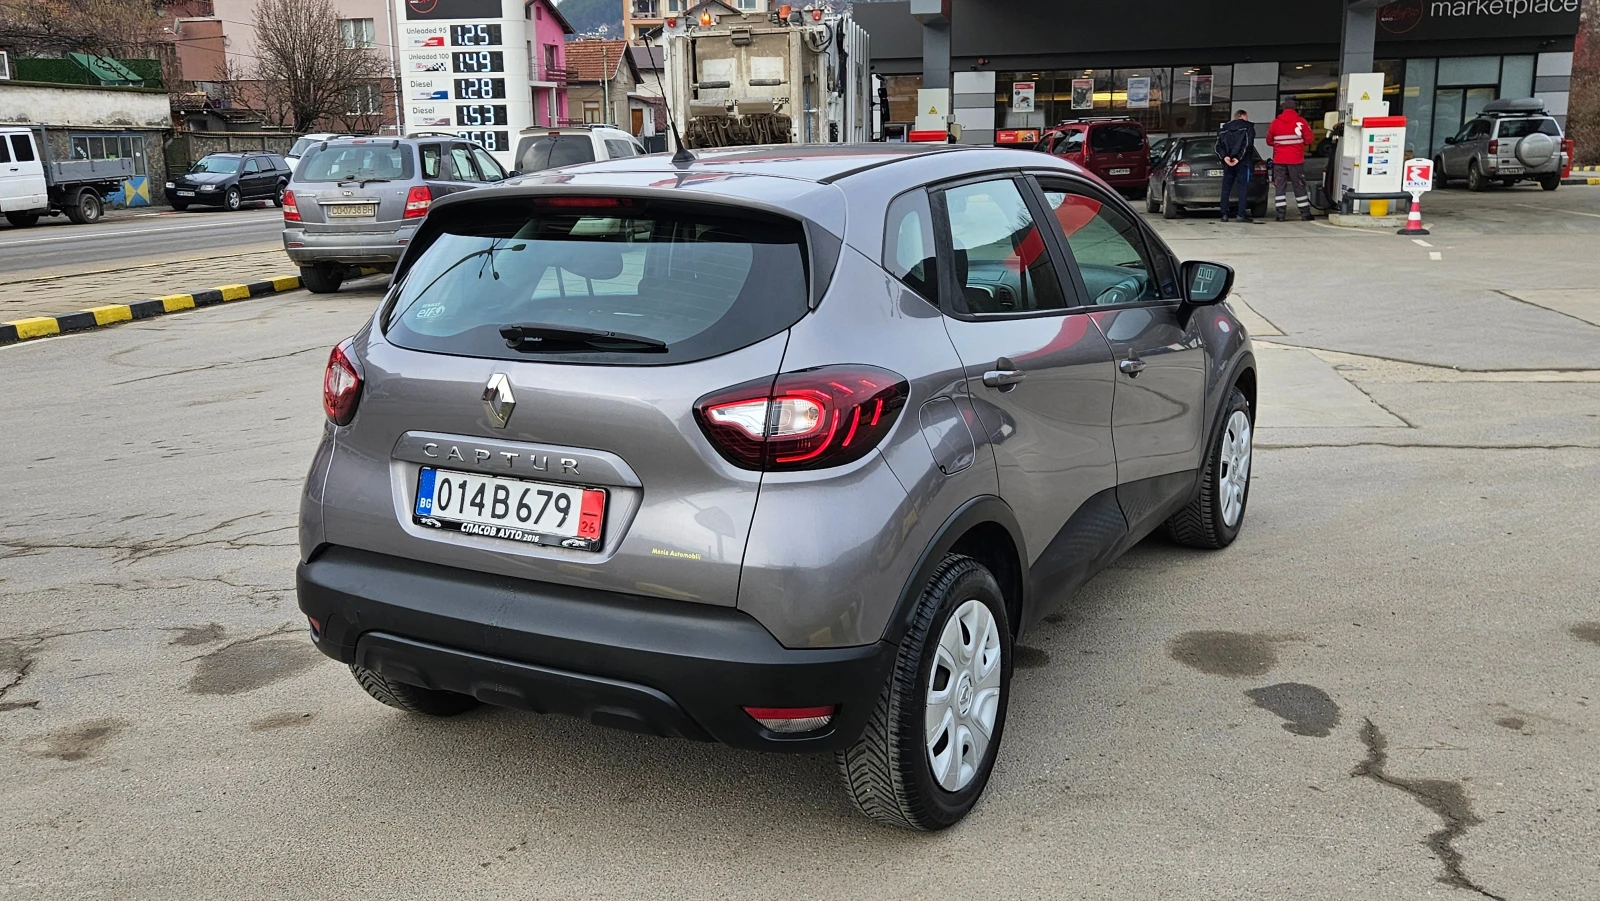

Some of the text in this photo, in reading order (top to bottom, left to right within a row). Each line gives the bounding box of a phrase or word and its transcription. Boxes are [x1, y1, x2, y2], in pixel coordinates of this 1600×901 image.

[1430, 0, 1578, 19] marketplace
[457, 24, 489, 46] 1.25
[459, 51, 491, 72] 1.49
[410, 80, 433, 88] Diesel
[461, 78, 493, 99] 1.28
[412, 106, 435, 114] Diesel
[463, 105, 495, 125] 1.53
[422, 442, 580, 475] CAPTUR
[420, 497, 432, 509] BG
[437, 477, 572, 528] 014B679
[460, 523, 540, 543] СПАСОВ АУТО 2016
[580, 520, 596, 534] 26
